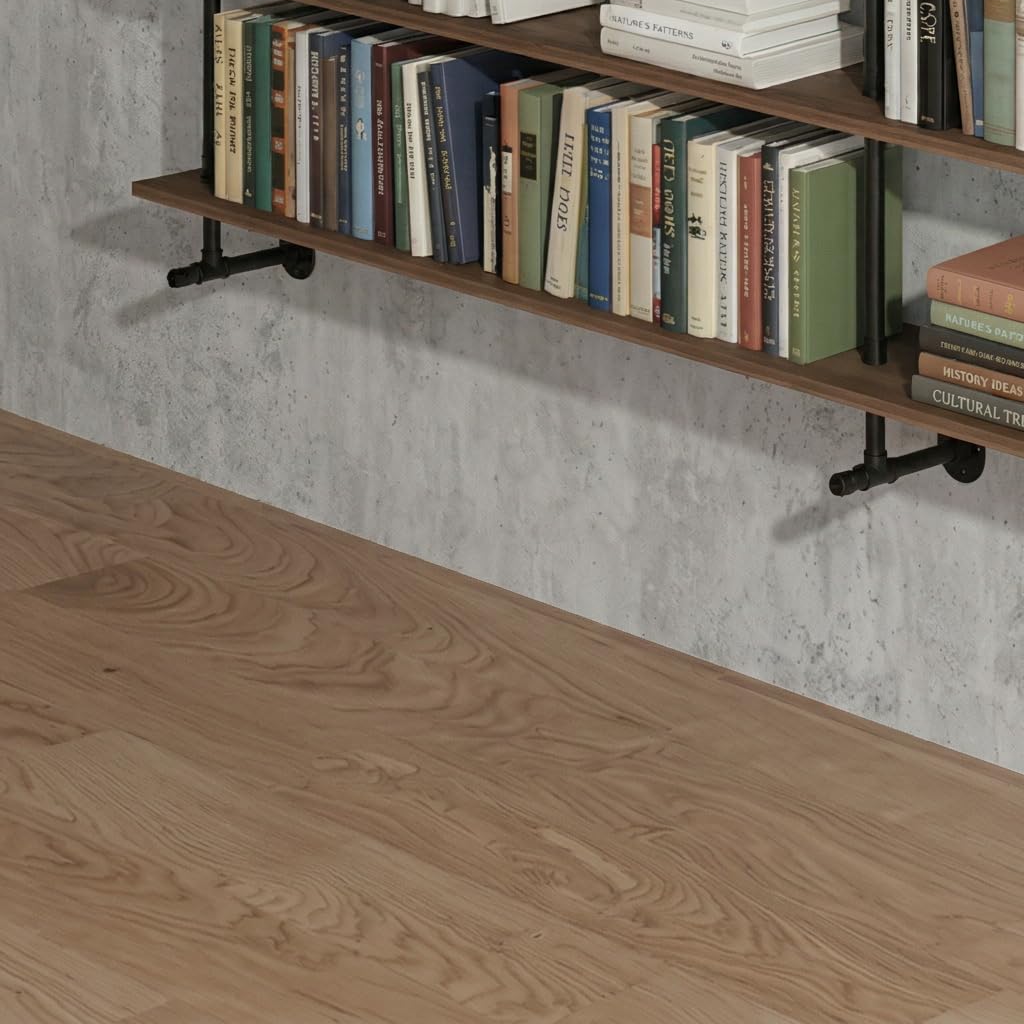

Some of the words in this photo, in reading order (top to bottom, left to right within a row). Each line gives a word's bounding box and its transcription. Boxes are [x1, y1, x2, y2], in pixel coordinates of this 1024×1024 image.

[943, 366, 989, 388] HISTORY
[991, 378, 1024, 397] IDEAS
[932, 389, 1001, 420] CULTURAL
